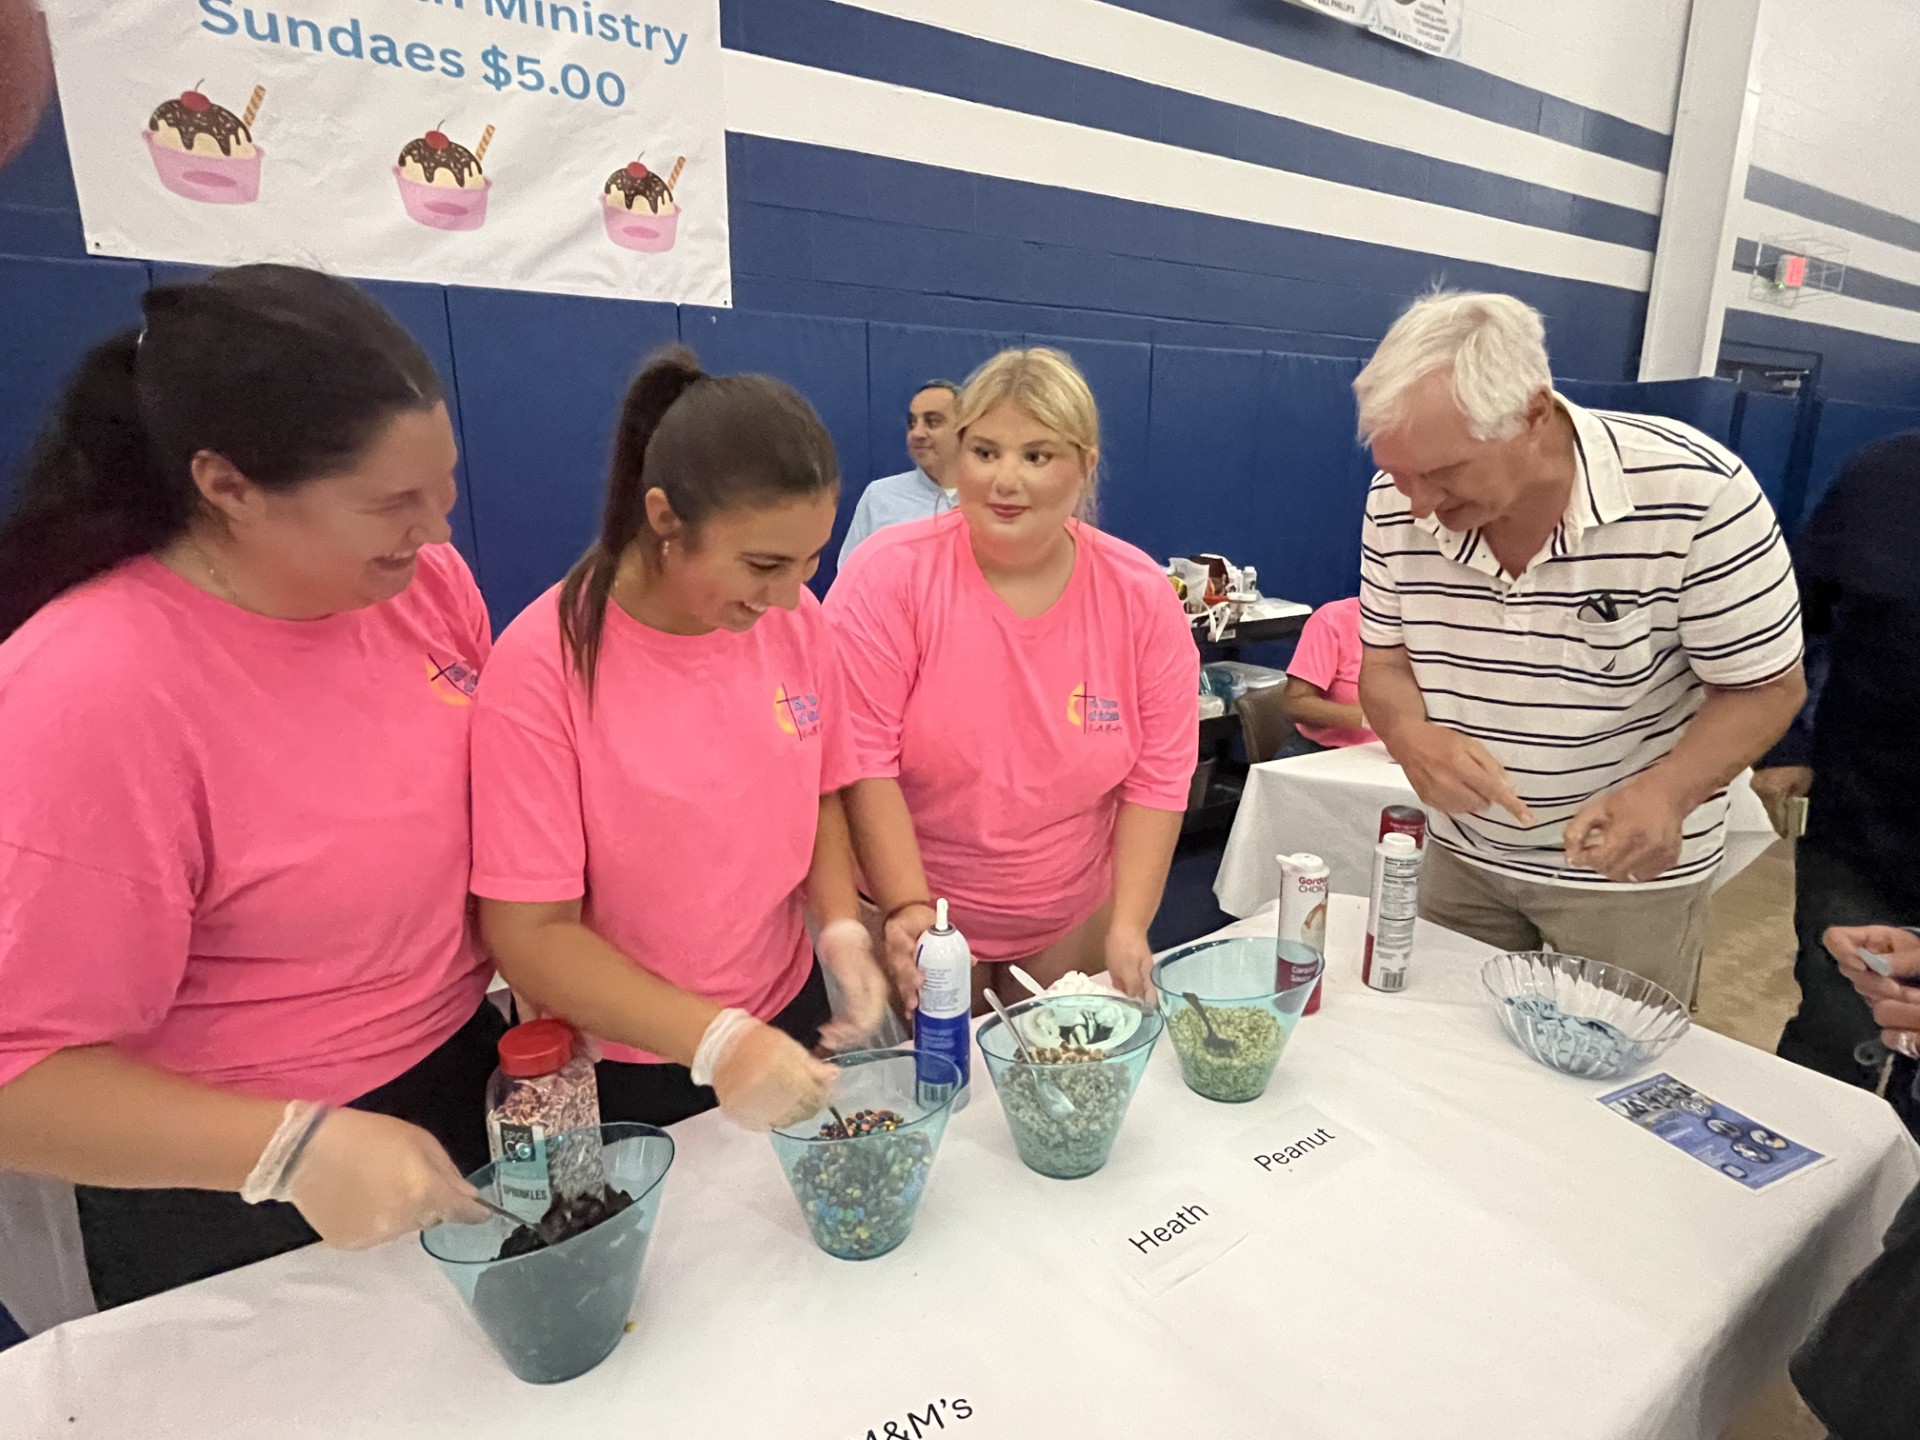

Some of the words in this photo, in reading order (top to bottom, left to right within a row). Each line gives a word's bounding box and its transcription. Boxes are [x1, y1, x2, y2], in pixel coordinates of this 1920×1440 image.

[198, 0, 465, 78] Sundaes
[481, 44, 626, 107] $5.00
[1253, 1128, 1336, 1171] Peanut
[1128, 1205, 1209, 1254] Heath
